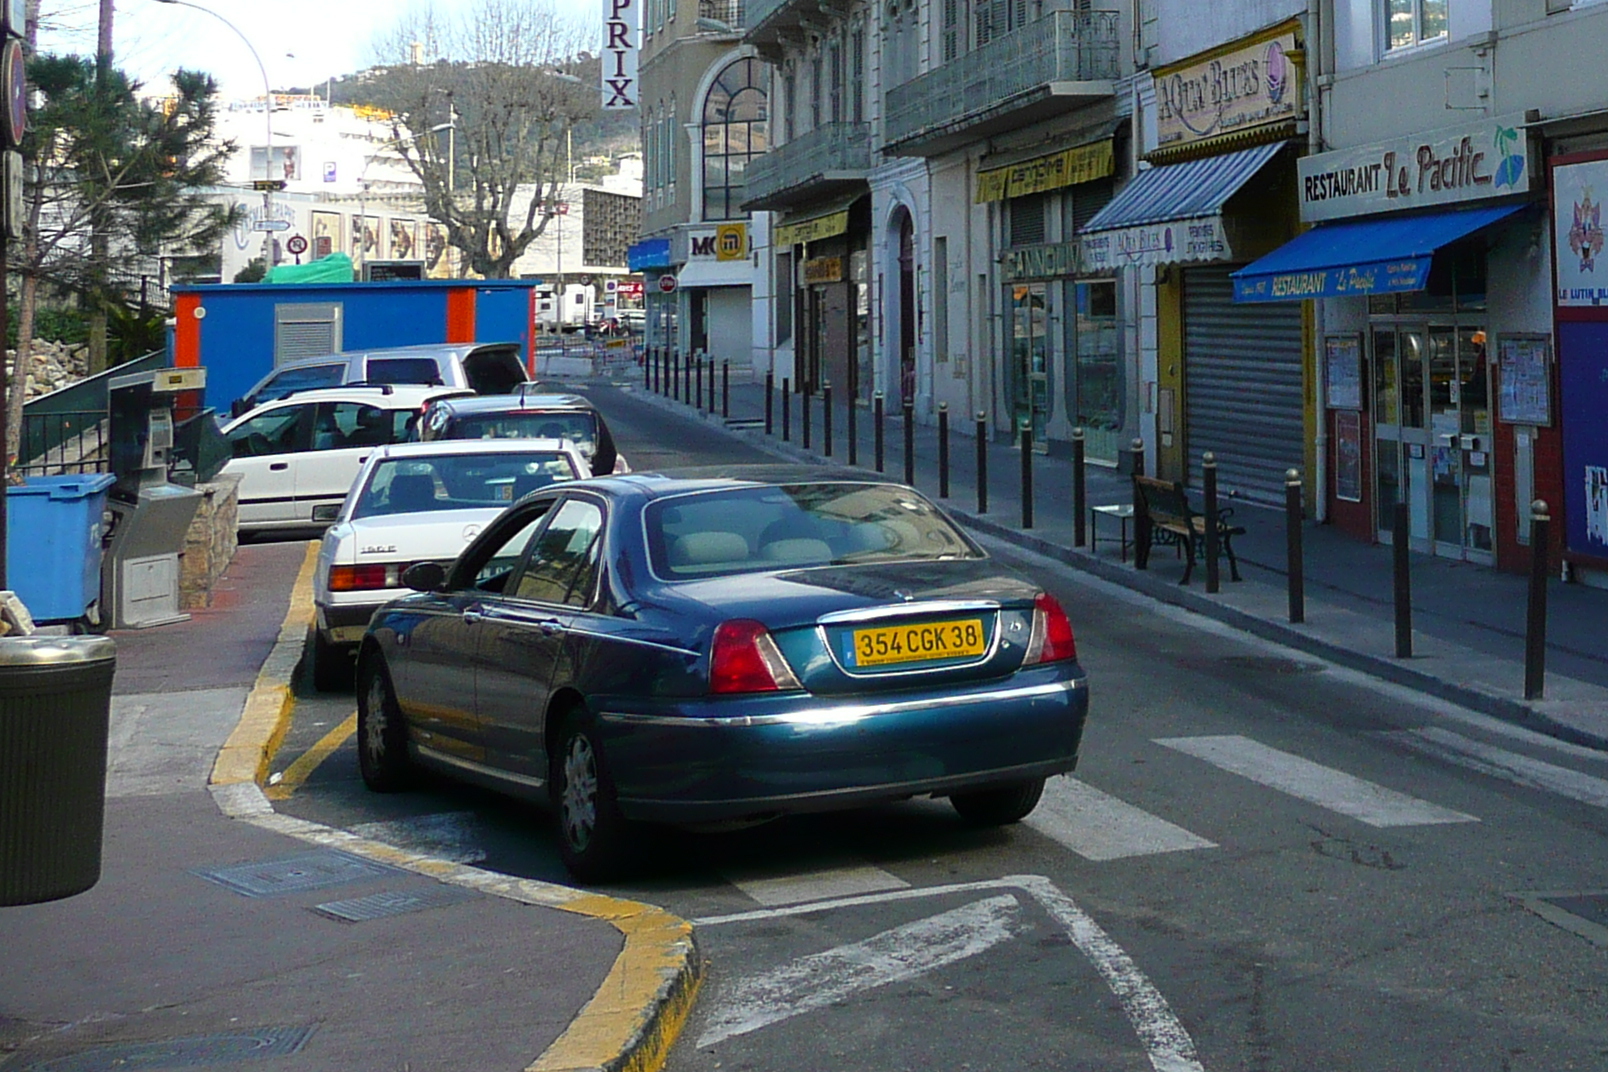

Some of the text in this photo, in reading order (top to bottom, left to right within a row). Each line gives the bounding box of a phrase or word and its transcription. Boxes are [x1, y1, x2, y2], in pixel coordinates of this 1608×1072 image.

[1304, 136, 1493, 202] RESTAURANT Le Pacific
[1271, 273, 1328, 297] RESTAURANT
[1558, 289, 1568, 300] LE
[1570, 288, 1594, 300] LUTIN
[860, 633, 903, 658] 354
[906, 627, 948, 653] CGK
[949, 624, 978, 649] 38
